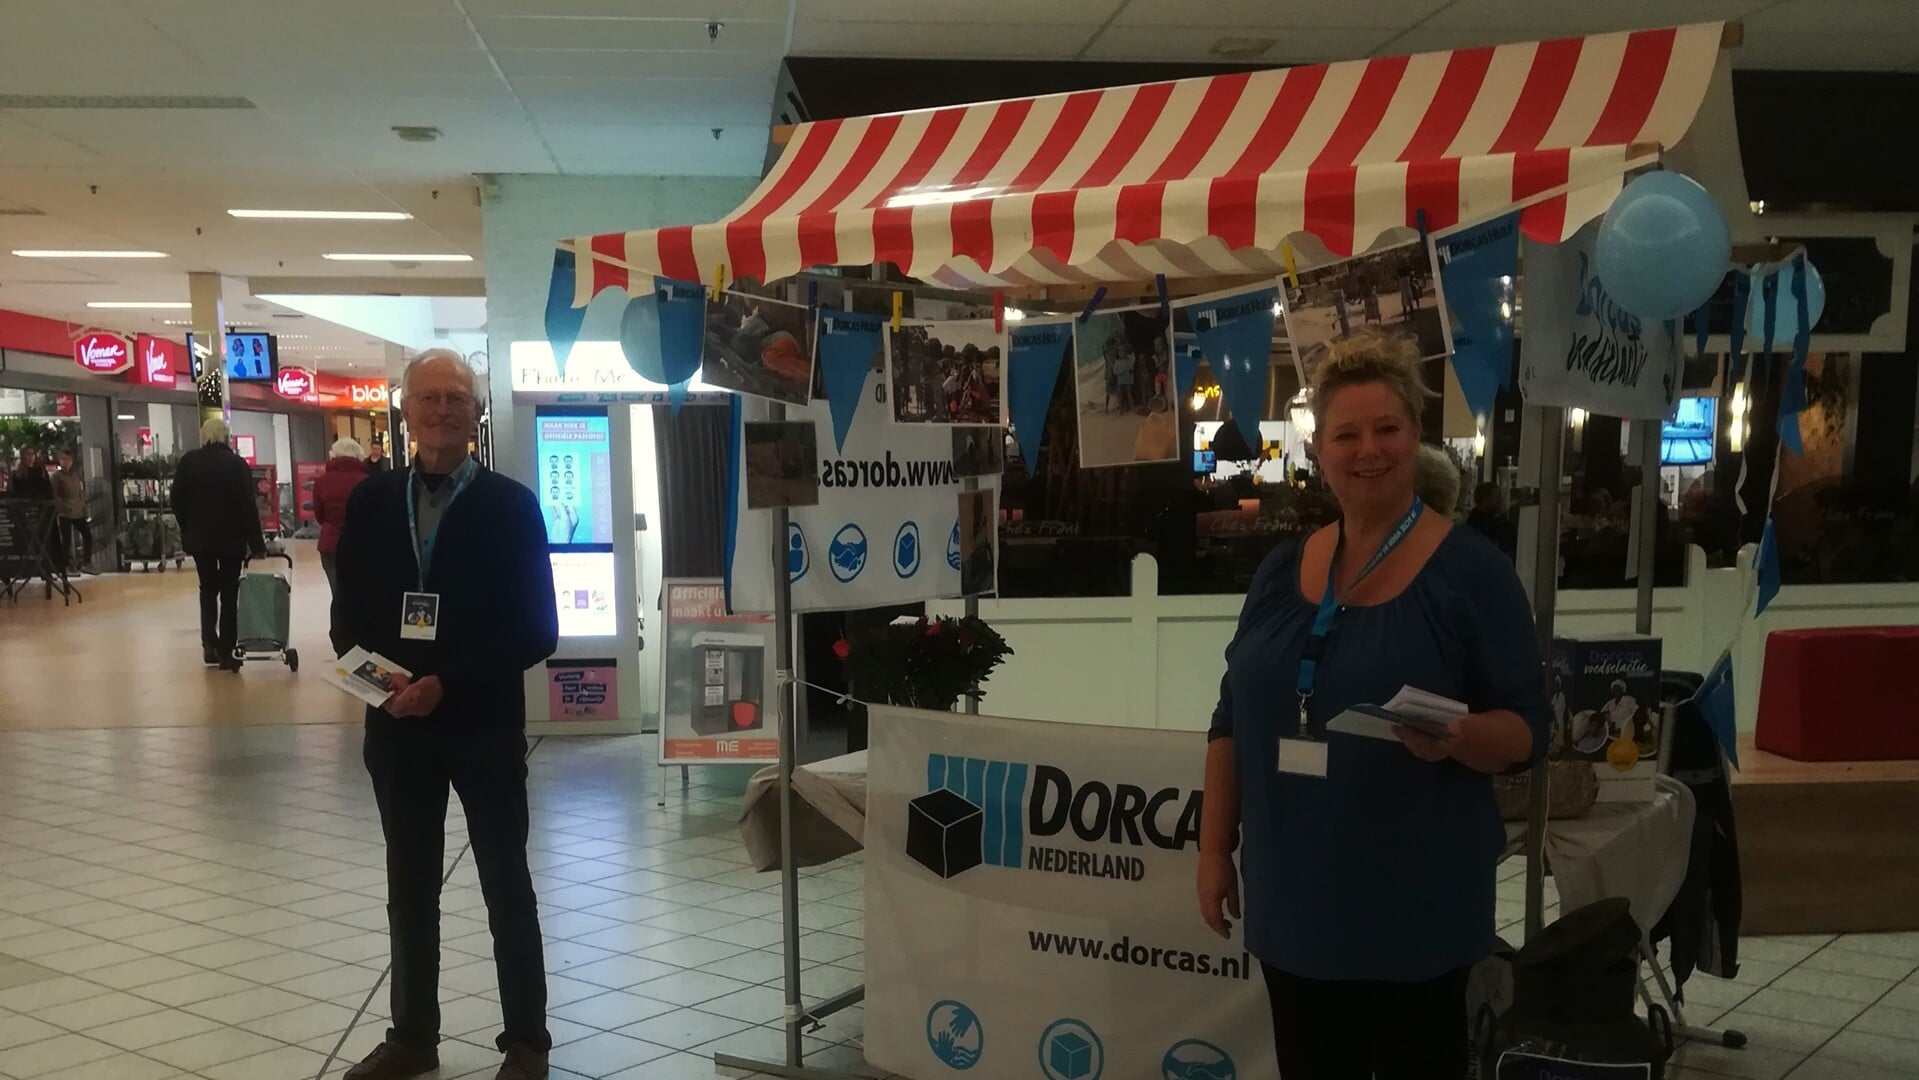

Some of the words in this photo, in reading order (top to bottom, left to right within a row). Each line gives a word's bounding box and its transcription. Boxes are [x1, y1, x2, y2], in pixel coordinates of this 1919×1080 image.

[671, 606, 711, 618] maakt
[716, 740, 739, 752] ME
[1029, 765, 1240, 852] DORCA
[1028, 846, 1145, 882] NEDERLAND
[1028, 930, 1250, 980] www.dorcas.nl
